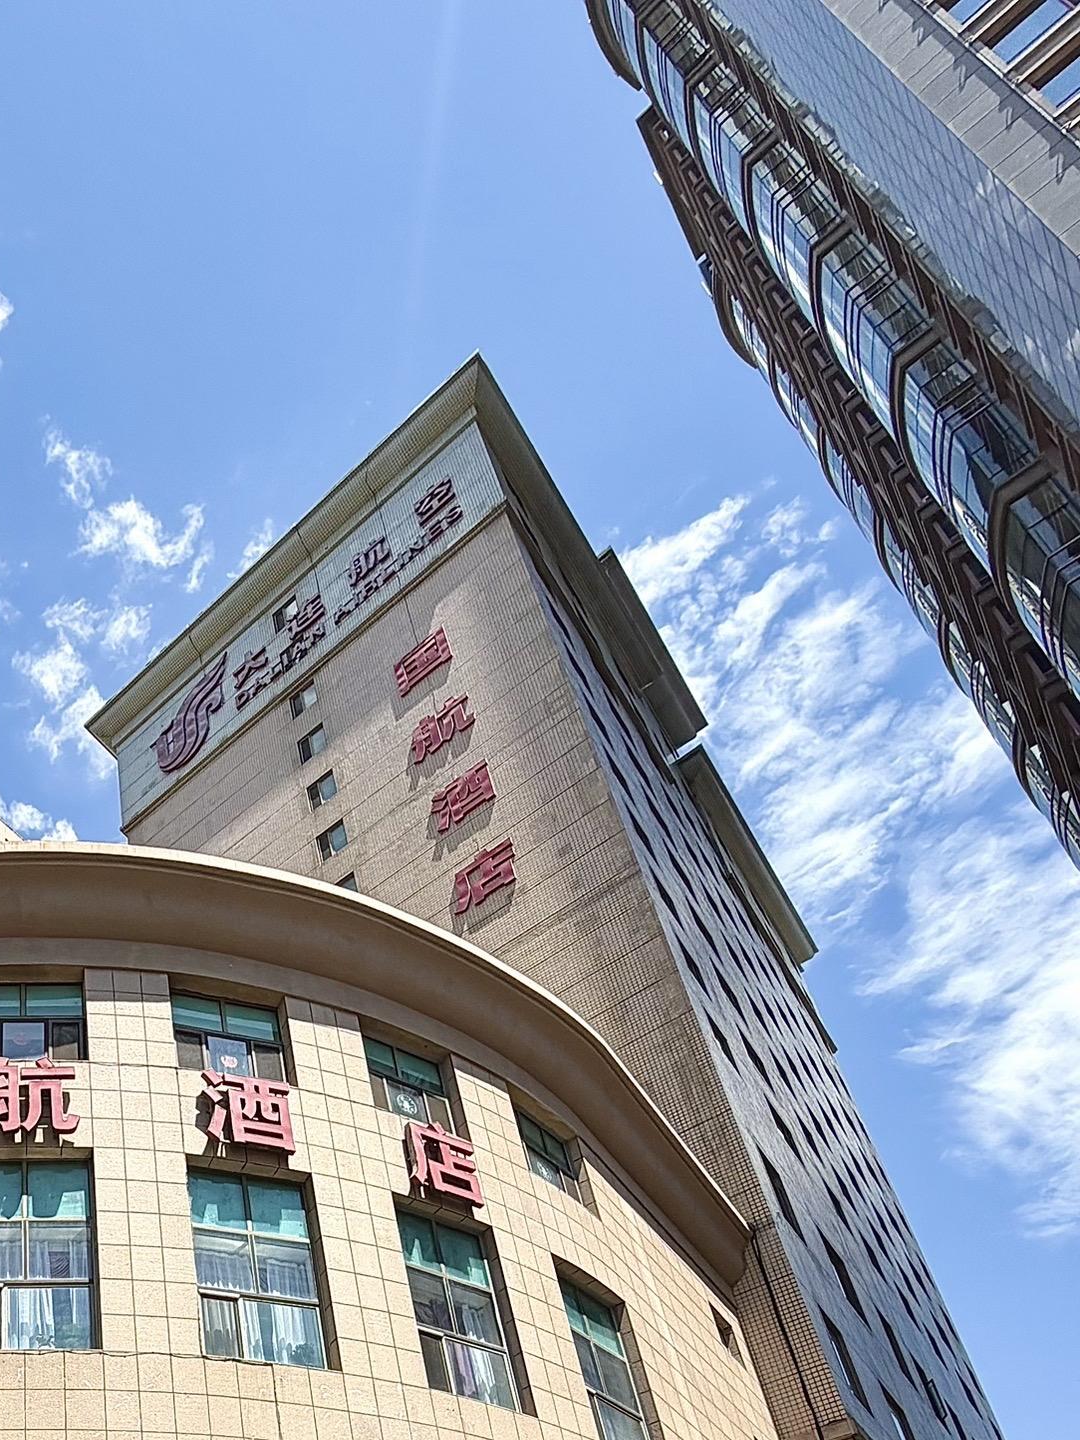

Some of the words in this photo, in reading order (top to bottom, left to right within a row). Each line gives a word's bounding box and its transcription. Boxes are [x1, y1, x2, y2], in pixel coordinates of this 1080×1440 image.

[233, 475, 459, 688] 大连航空
[393, 625, 518, 914] 国航酒店
